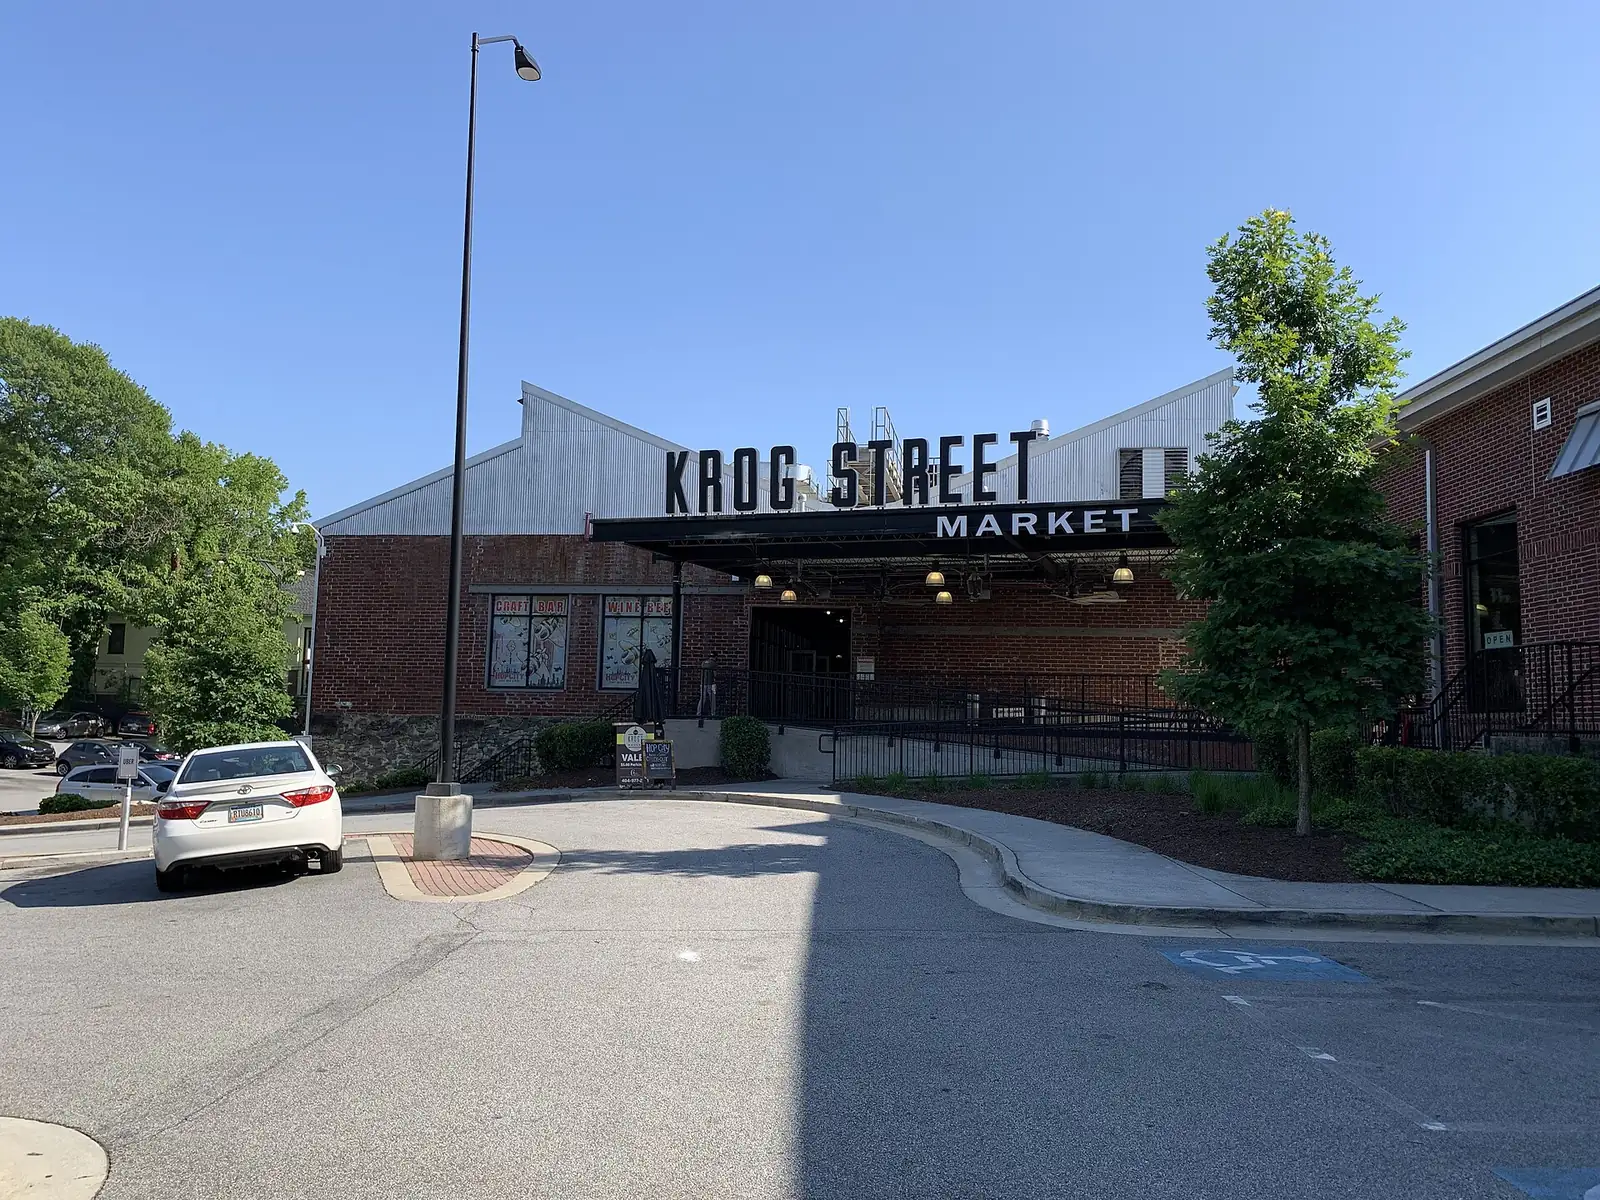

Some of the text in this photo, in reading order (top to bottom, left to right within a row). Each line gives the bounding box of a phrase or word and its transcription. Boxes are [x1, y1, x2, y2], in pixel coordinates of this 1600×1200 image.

[666, 430, 1038, 514] KROG STREET
[936, 508, 1139, 538] MARKET
[496, 601, 564, 612] CRAFT BAR
[608, 601, 671, 613] WINE BEE
[1486, 634, 1512, 644] OPEN
[621, 754, 642, 762] VALE
